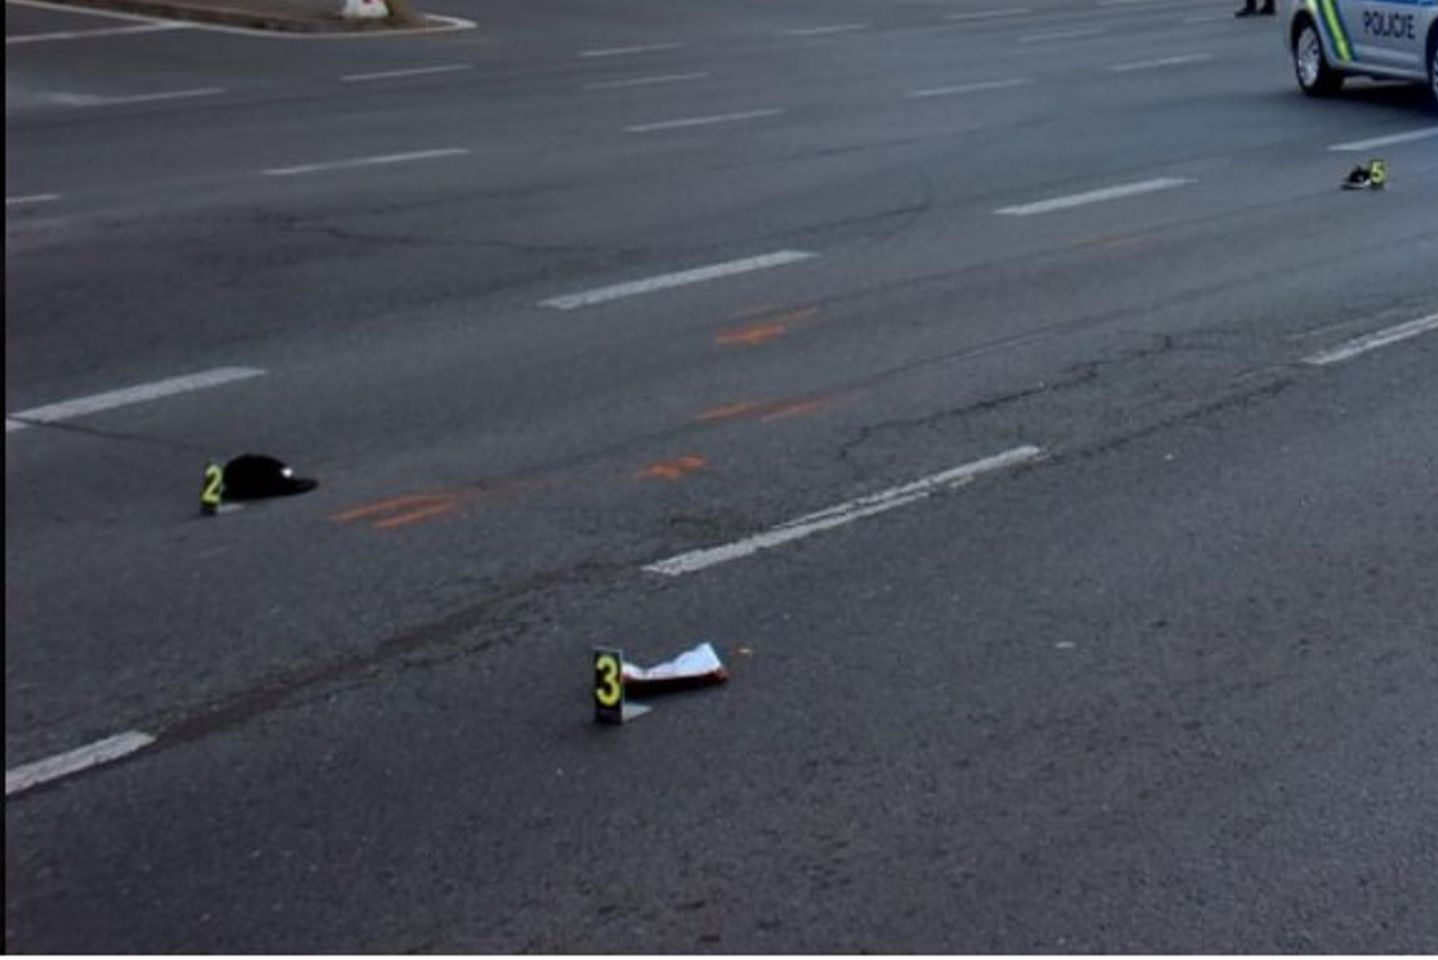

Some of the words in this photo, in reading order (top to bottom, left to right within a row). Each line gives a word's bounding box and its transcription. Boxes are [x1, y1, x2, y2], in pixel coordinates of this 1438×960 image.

[1363, 9, 1416, 39] POLICIE
[1370, 161, 1384, 183] 5
[202, 464, 222, 502] 2
[597, 655, 621, 707] 3
